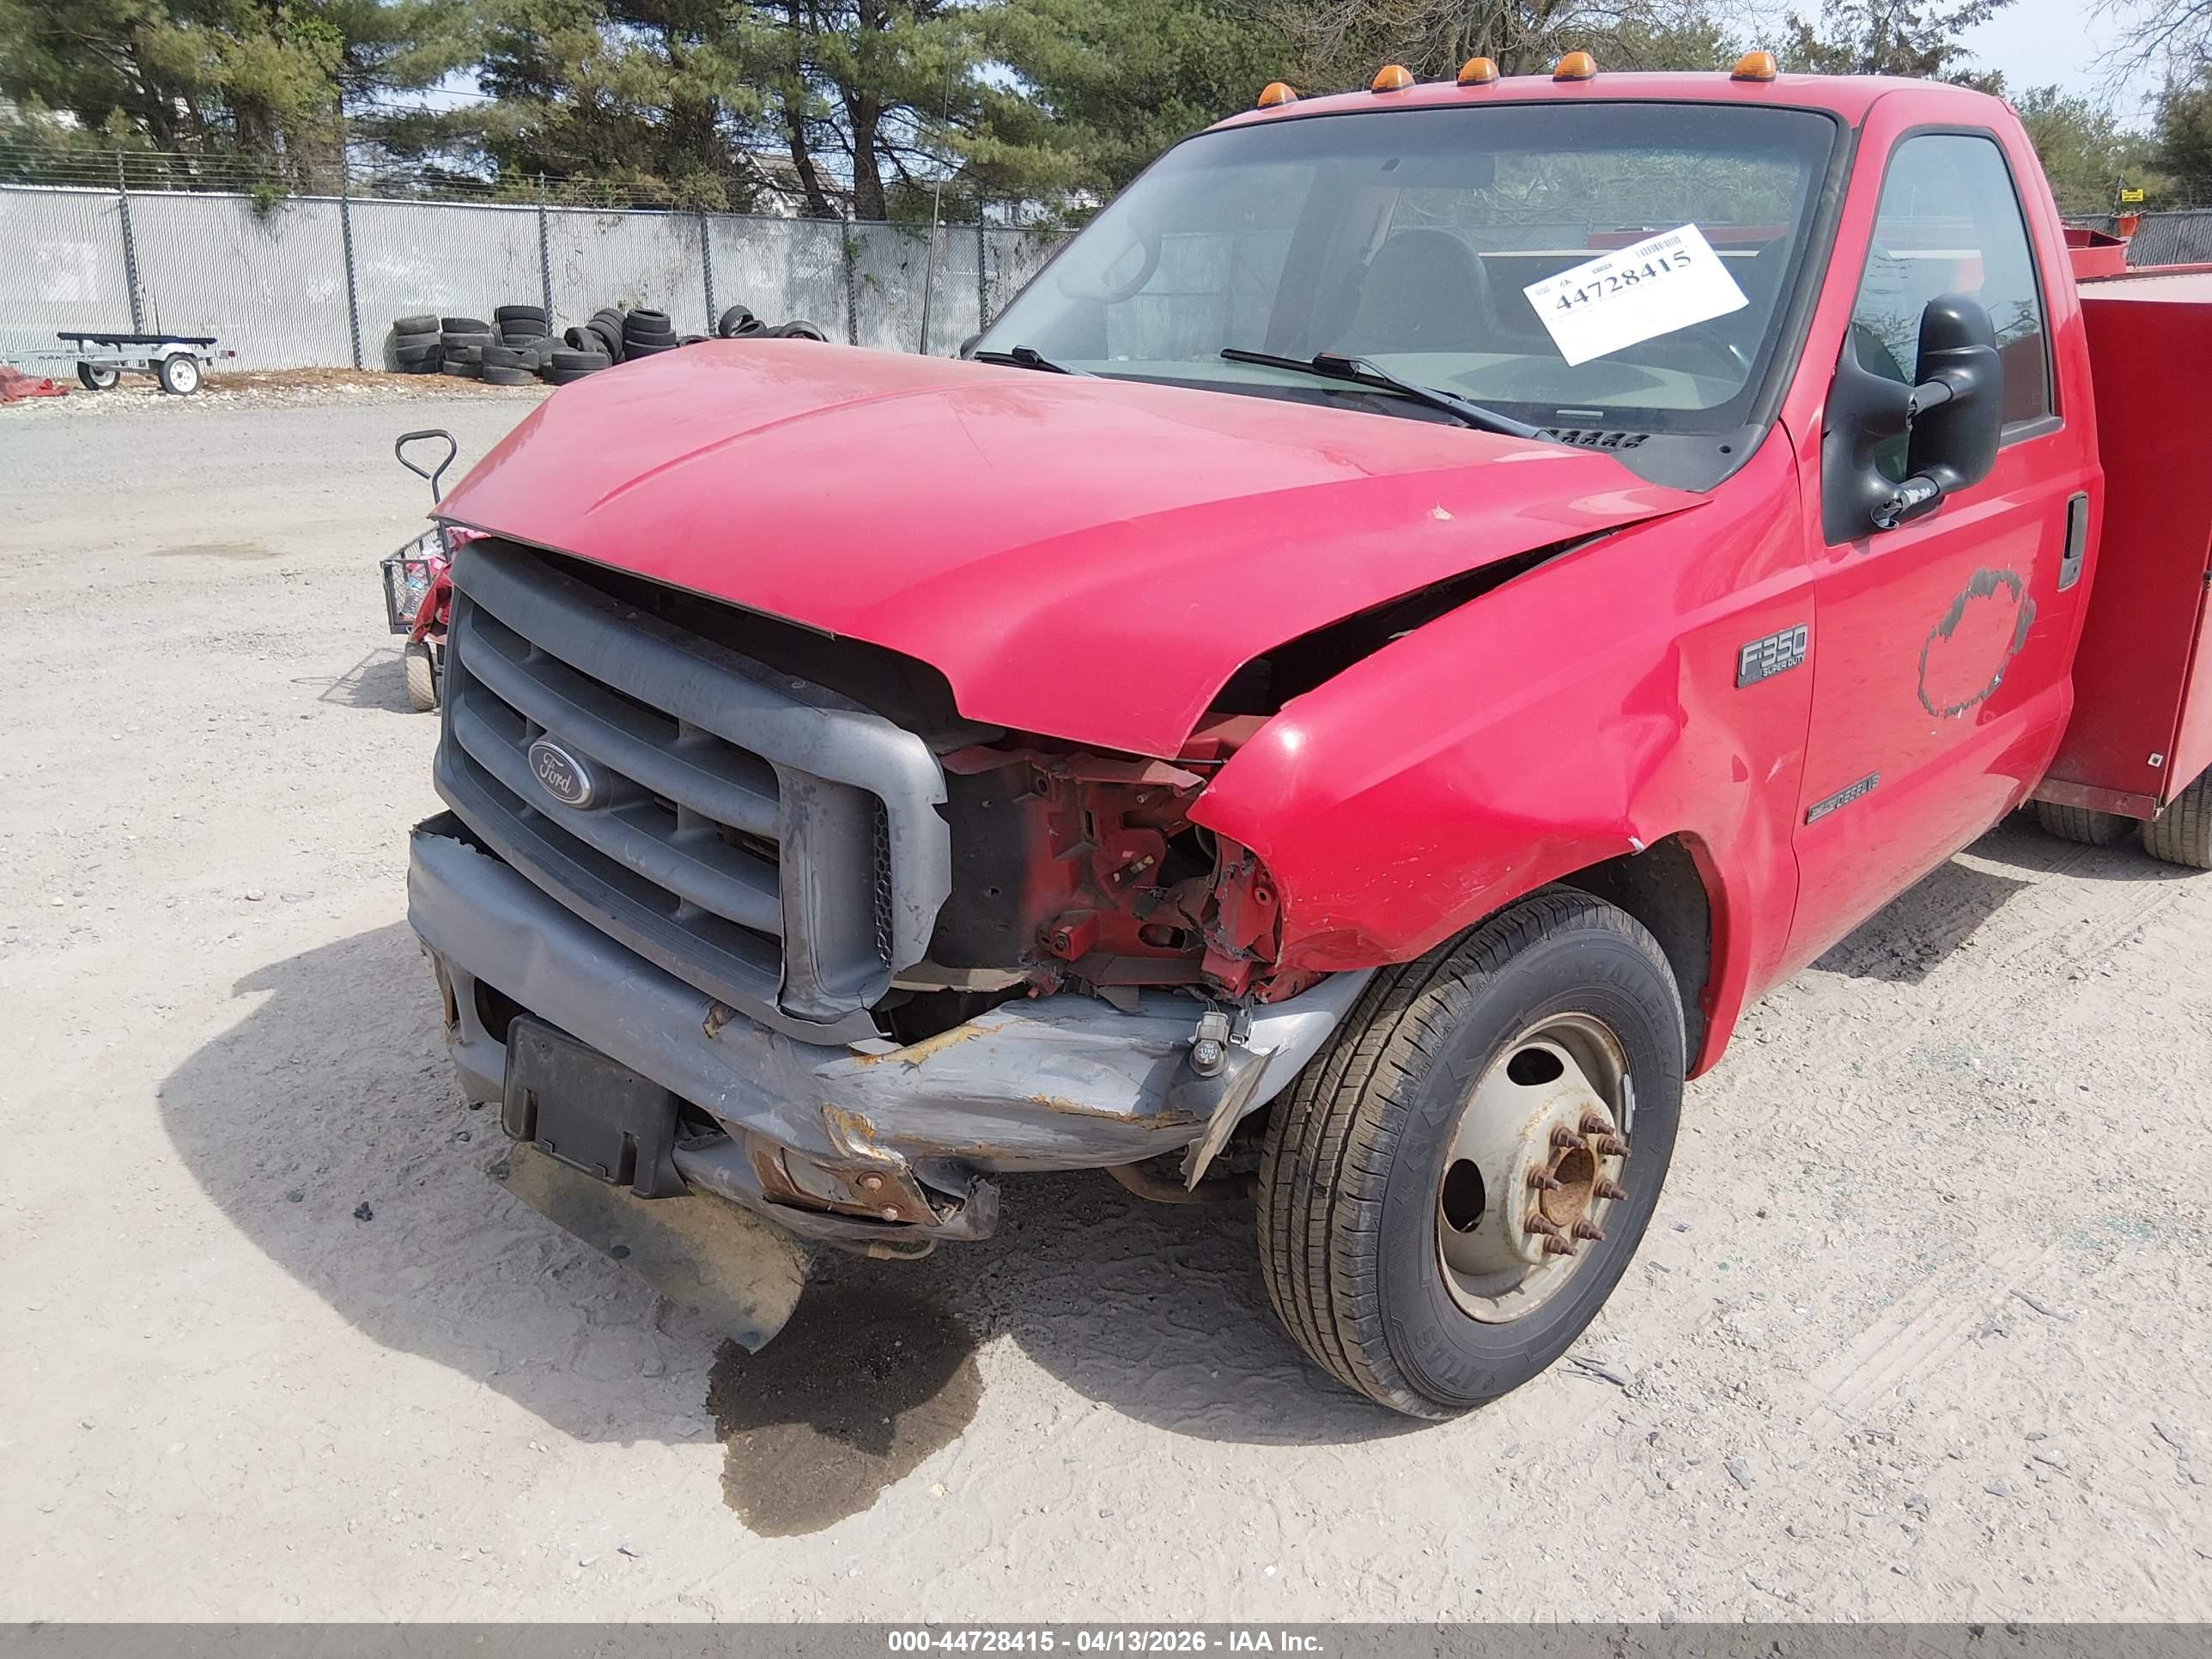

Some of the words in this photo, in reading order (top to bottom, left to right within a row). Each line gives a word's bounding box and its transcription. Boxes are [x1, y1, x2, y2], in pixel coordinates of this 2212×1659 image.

[1556, 250, 1692, 310] 44728415
[1762, 660, 1787, 677] SUPER
[539, 752, 572, 794] Ford
